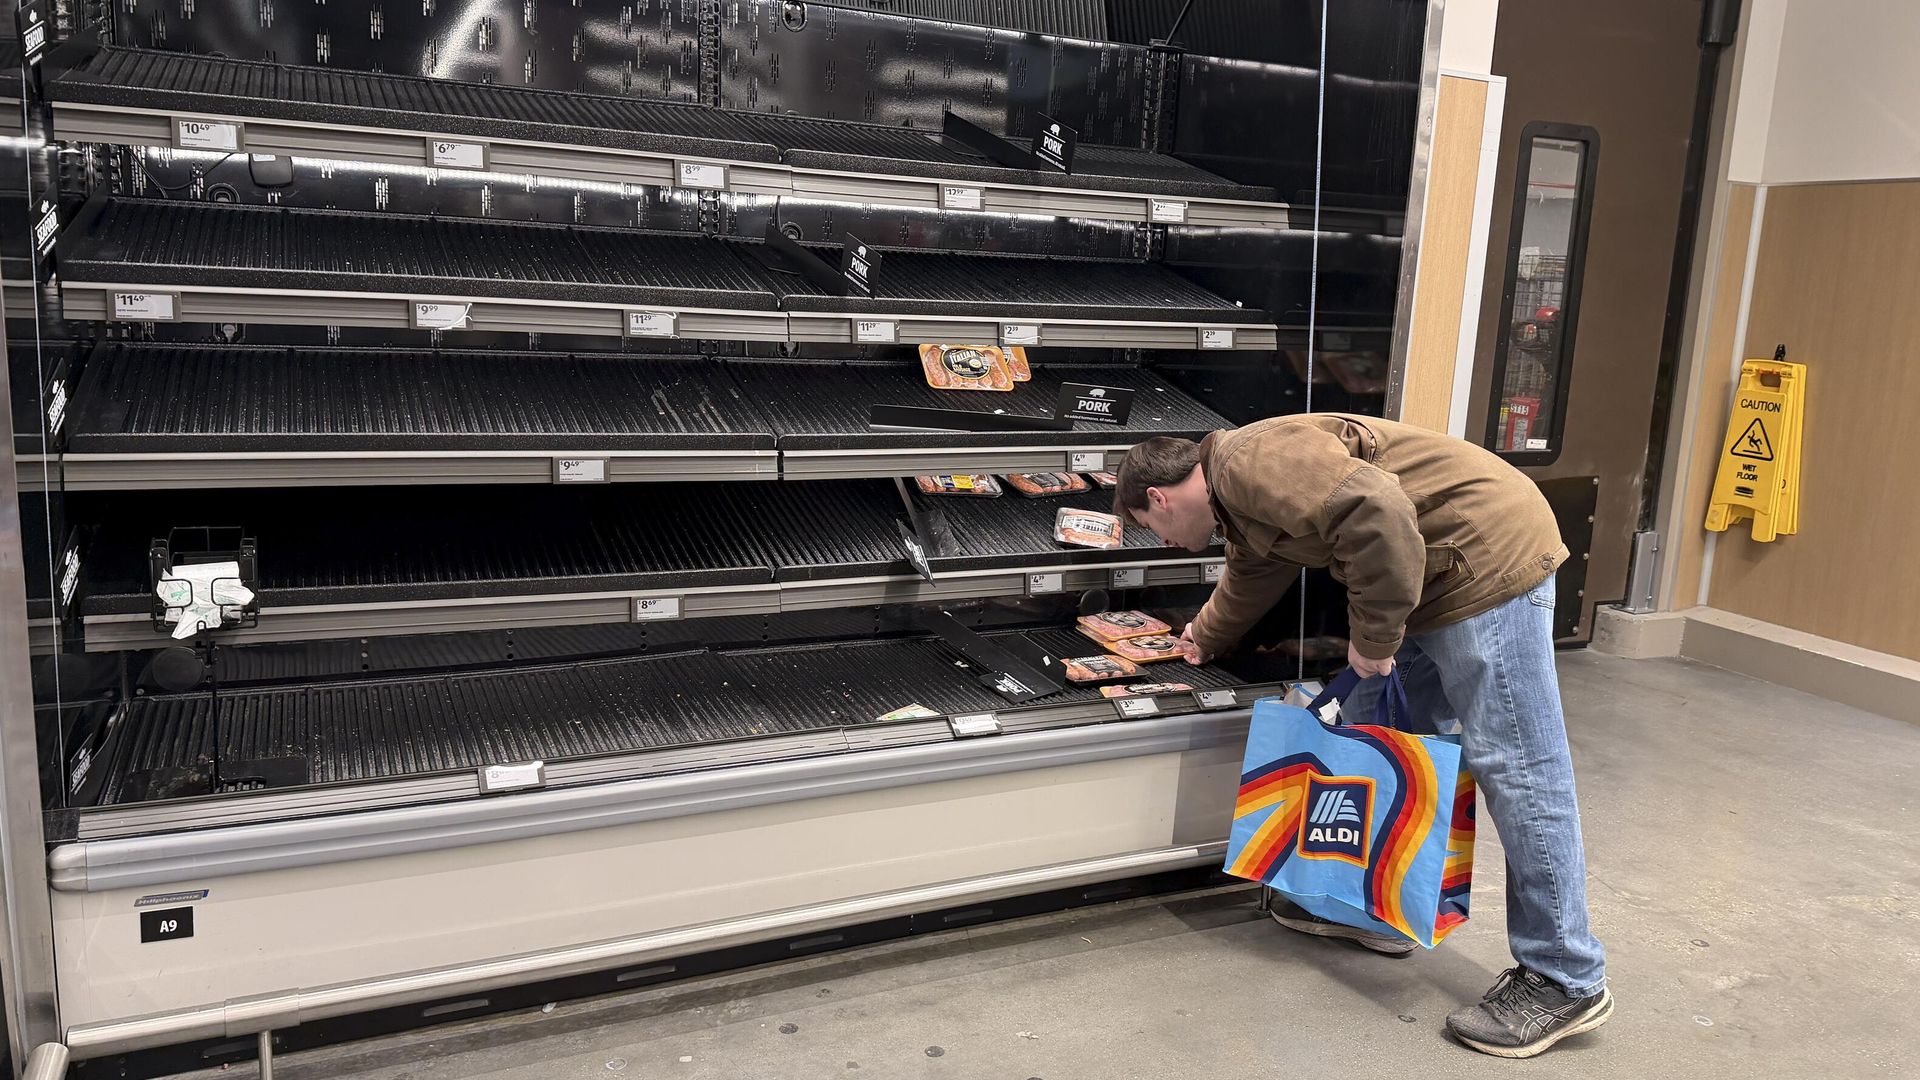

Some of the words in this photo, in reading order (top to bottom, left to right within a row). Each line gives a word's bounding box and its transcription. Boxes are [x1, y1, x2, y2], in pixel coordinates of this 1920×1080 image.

[25, 26, 44, 52] SEAFOOD
[1043, 135, 1062, 156] PORK
[37, 211, 57, 245] SEAFOOD
[851, 256, 868, 279] PORK
[1078, 400, 1111, 413] PORK
[1740, 398, 1781, 413] CAUTION
[1742, 463, 1757, 472] WET
[1736, 471, 1758, 482] FLOOR
[1308, 828, 1360, 846] ALDI
[160, 919, 178, 933] A9
